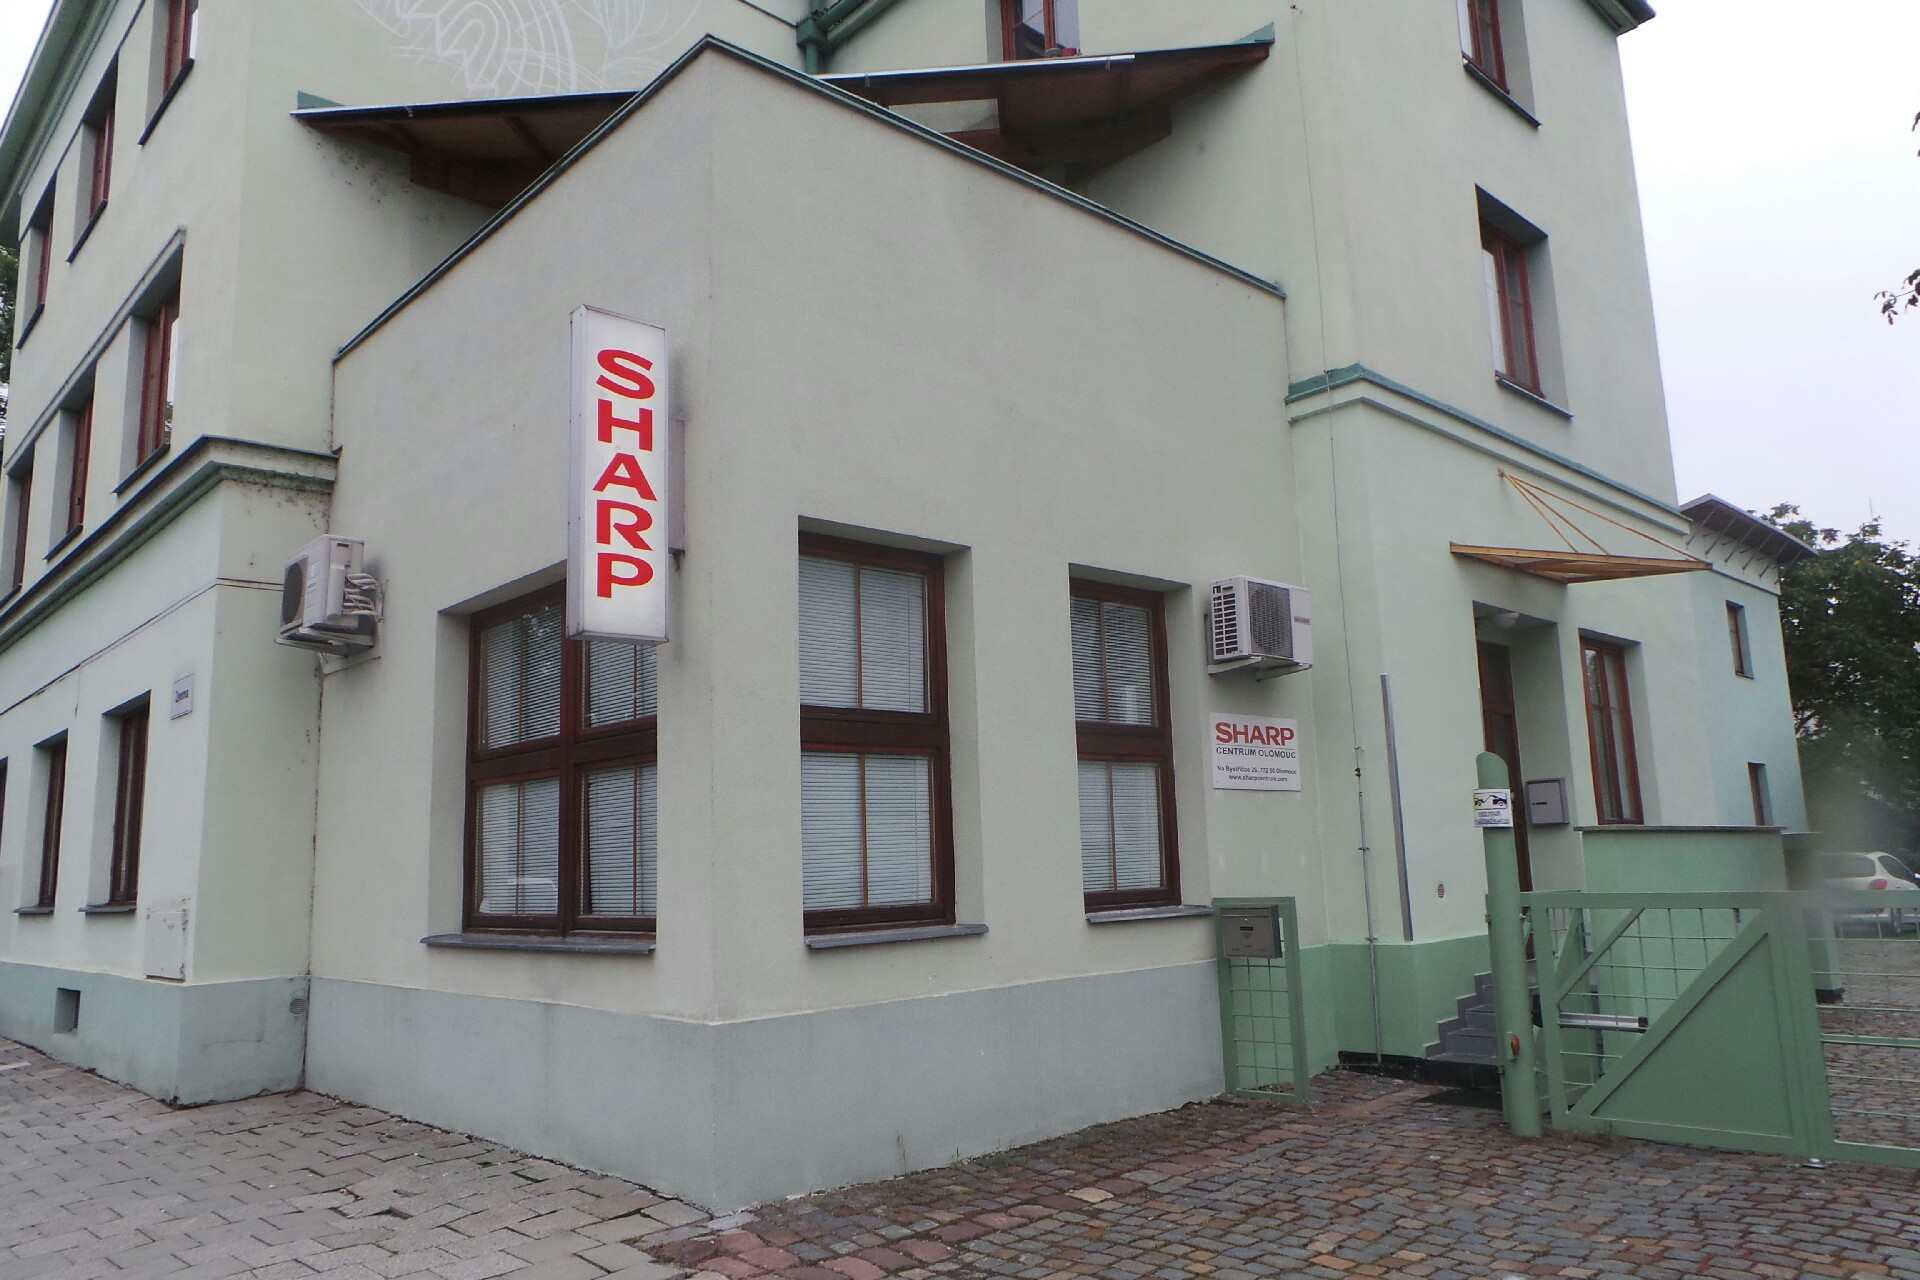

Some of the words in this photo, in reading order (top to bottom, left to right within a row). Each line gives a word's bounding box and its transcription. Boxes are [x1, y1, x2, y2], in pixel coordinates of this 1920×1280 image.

[593, 349, 657, 598] SHARP
[1215, 721, 1295, 746] SHARP
[1216, 746, 1257, 756] CENTRUM
[1258, 749, 1296, 759] OLOMOUC
